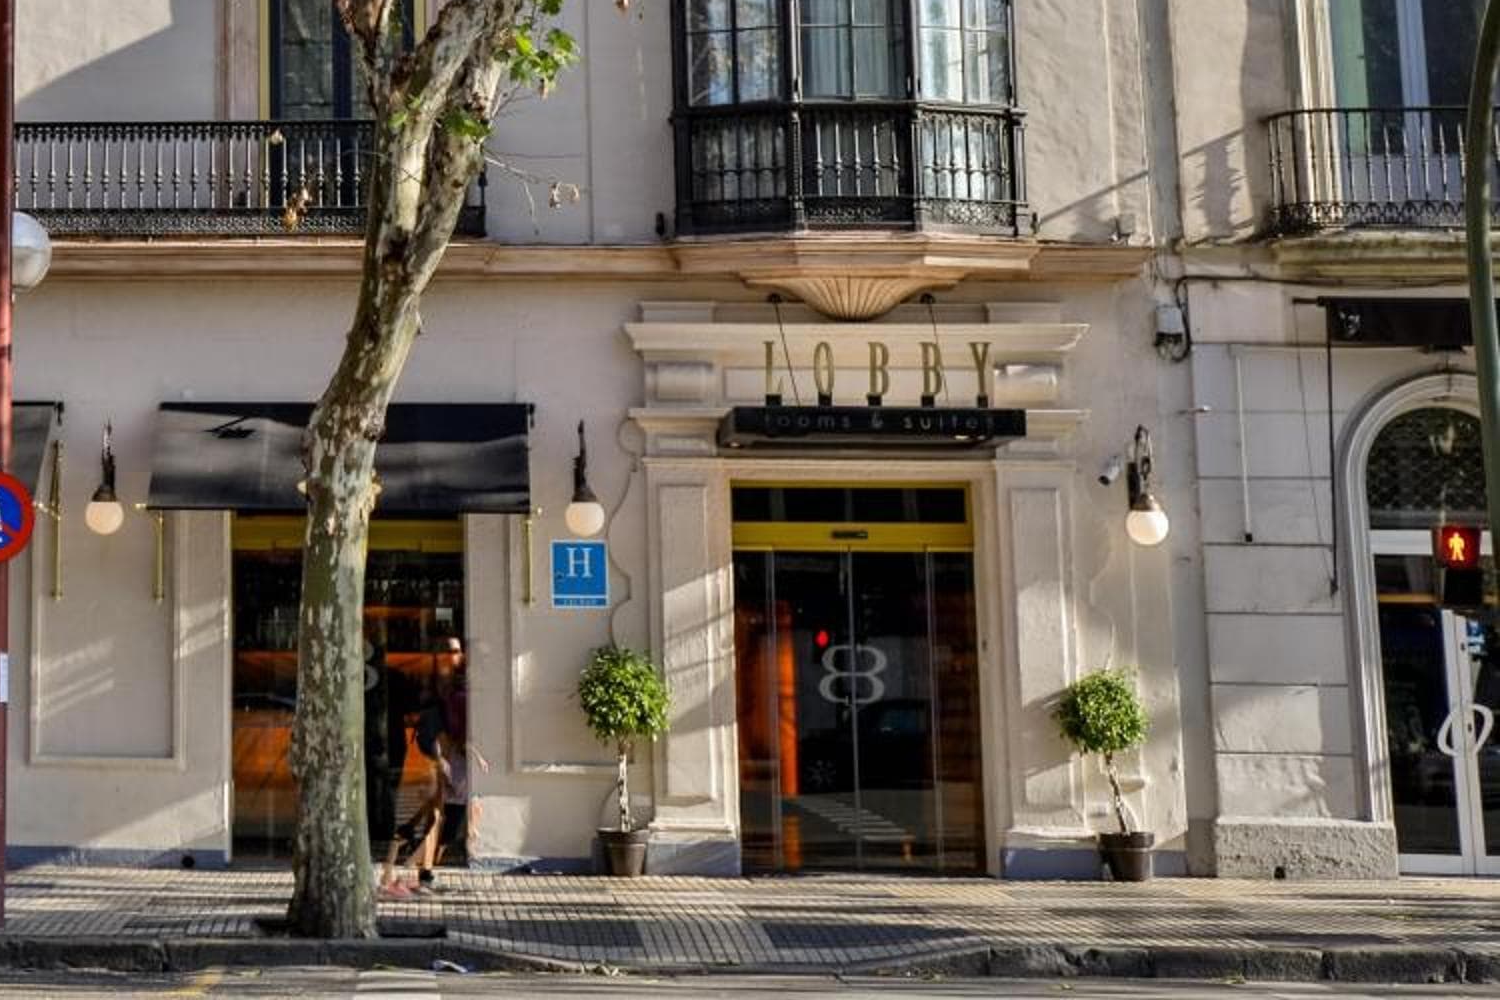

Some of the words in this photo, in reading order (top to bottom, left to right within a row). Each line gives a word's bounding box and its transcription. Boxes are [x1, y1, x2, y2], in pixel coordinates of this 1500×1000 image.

[763, 341, 992, 396] LOBBY
[764, 413, 851, 429] rooms
[870, 411, 884, 429] &
[903, 411, 994, 431] suites
[565, 546, 594, 578] H
